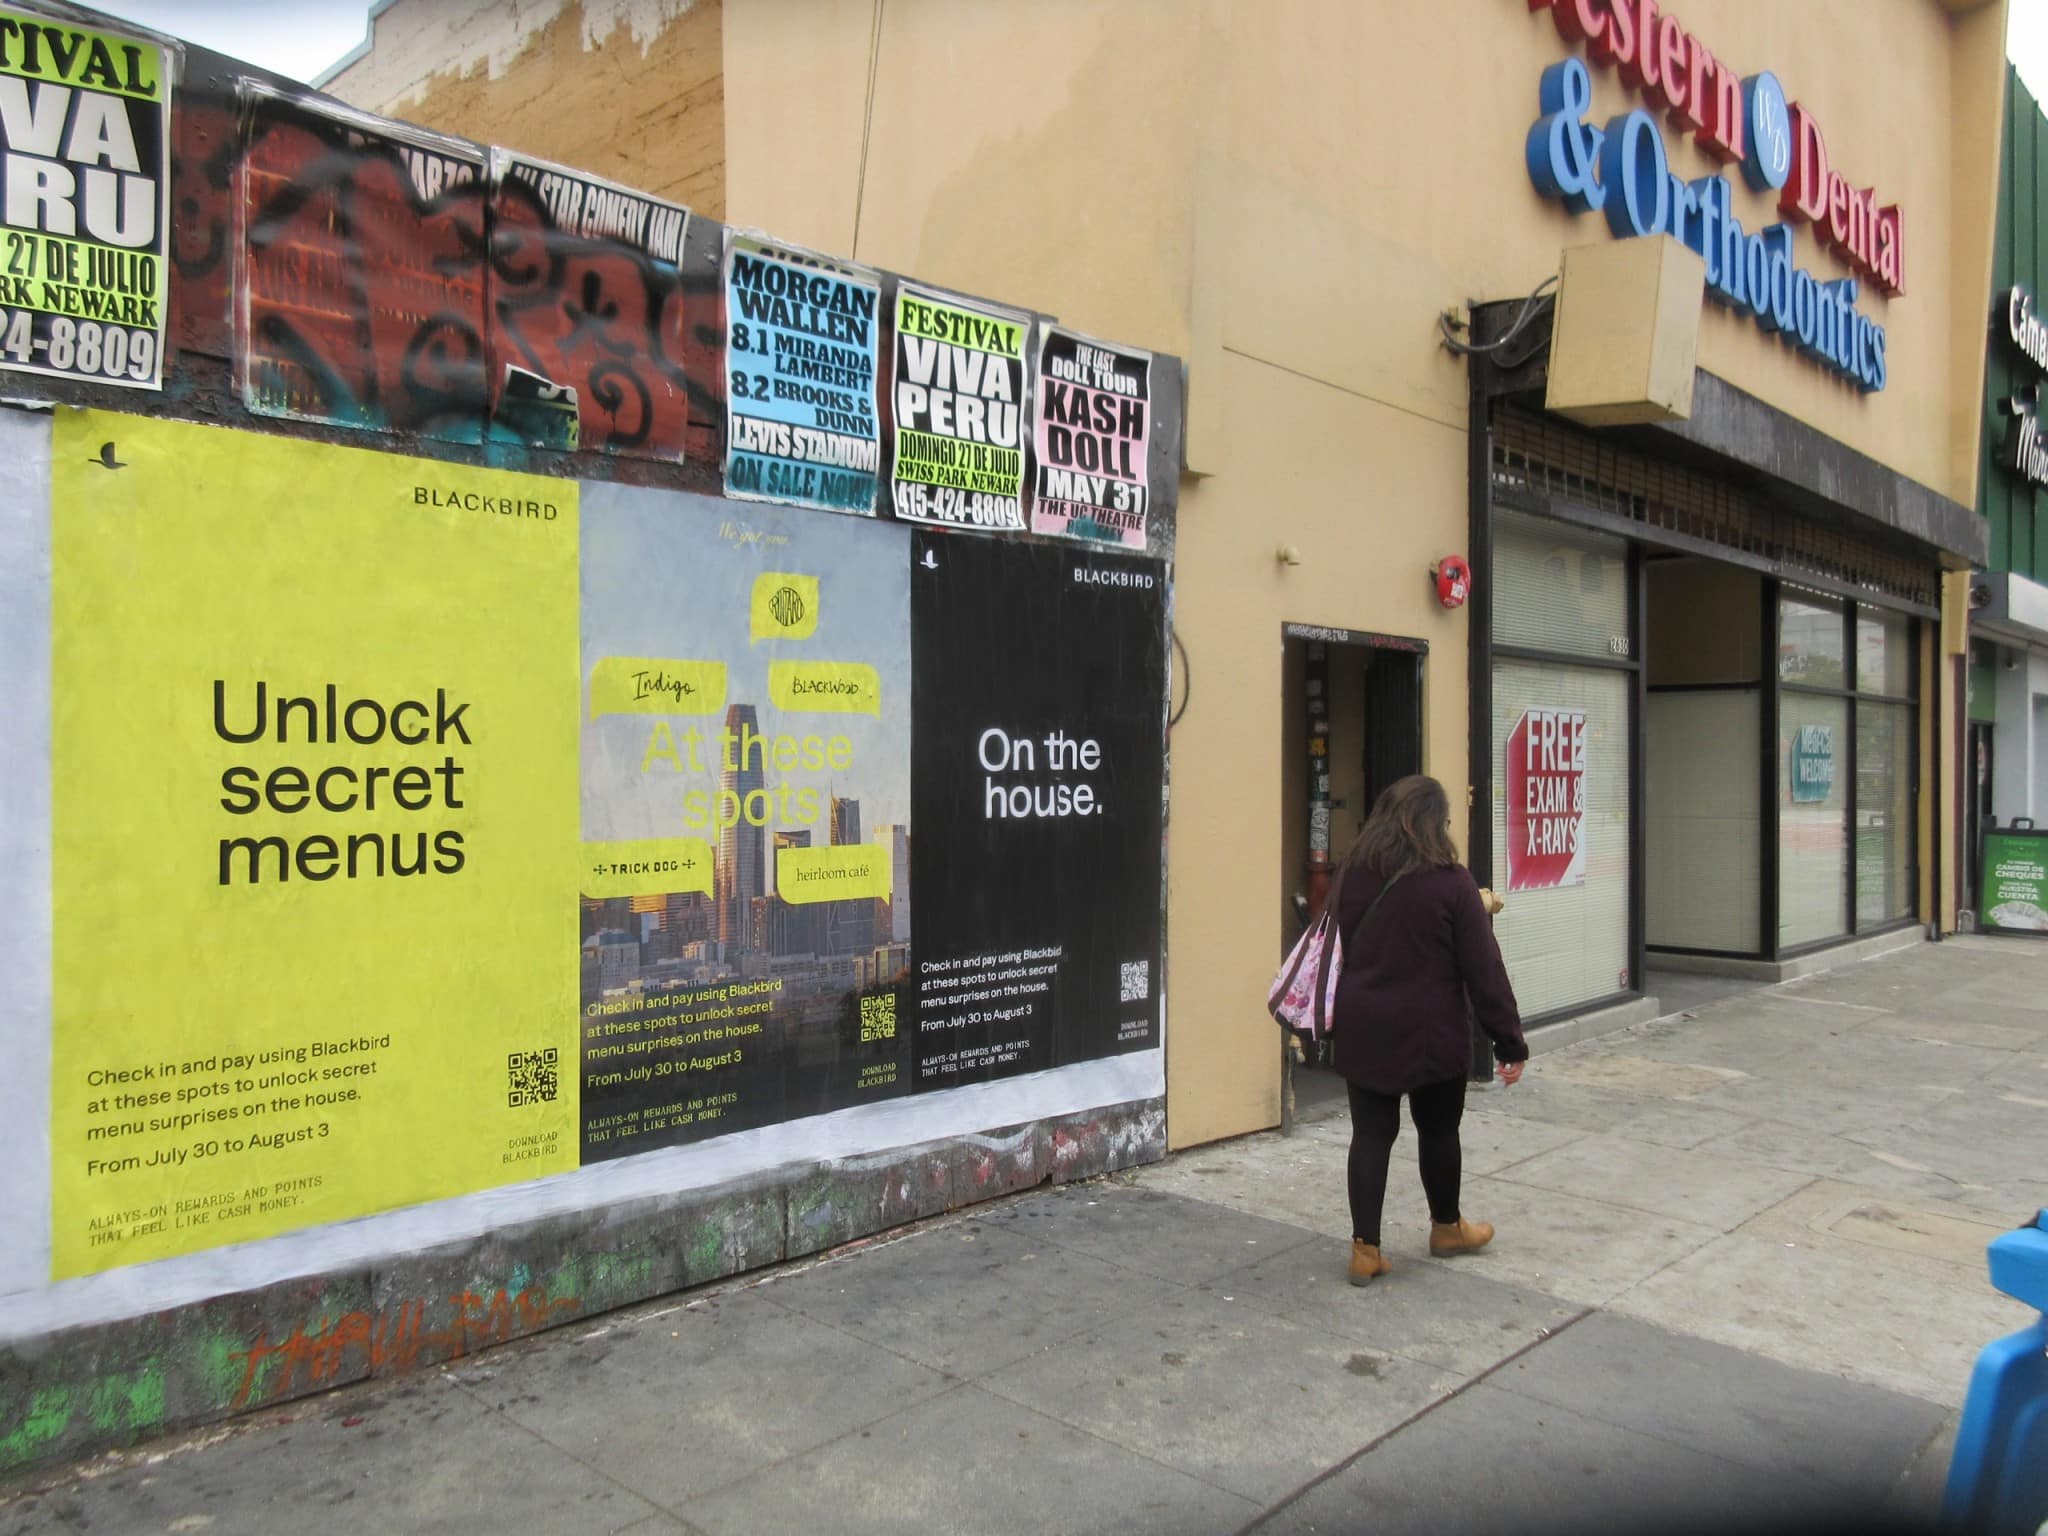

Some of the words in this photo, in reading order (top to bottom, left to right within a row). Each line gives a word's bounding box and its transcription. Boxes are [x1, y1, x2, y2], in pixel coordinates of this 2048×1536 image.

[7, 154, 155, 248] RU
[1795, 102, 1905, 297] Dental
[1539, 57, 1607, 210] &
[1612, 109, 1886, 392] Orthodontics
[7, 235, 38, 276] 27
[47, 241, 79, 284] DE
[86, 252, 155, 299] JULIO
[731, 254, 876, 320] MORGAN
[43, 283, 159, 327] NEWARK
[737, 288, 869, 348] WALLEN
[731, 323, 769, 356] 8.1
[774, 333, 872, 373] MIRANDA
[902, 299, 1018, 356] FESTIVAL
[775, 354, 871, 392] LAMBERT
[903, 334, 1012, 402] VIVA
[1052, 357, 1089, 386] DOLL
[1092, 370, 1137, 396] TOUR
[1076, 344, 1093, 365] THE
[1093, 346, 1116, 368] LAST
[731, 371, 770, 402] 8.2
[773, 378, 854, 413] BROOKS
[858, 397, 872, 415] &
[898, 381, 1017, 448] PERU
[1044, 380, 1144, 441] KASH
[815, 407, 873, 436] DUNN
[792, 428, 877, 472] STADIUM
[900, 431, 955, 467] DOMINGO
[959, 440, 972, 468] 27
[973, 446, 988, 472] DE
[990, 448, 1019, 477] JULIO
[1048, 424, 1136, 480] DOLL
[731, 456, 763, 492] ON
[768, 459, 815, 498] SALE
[897, 459, 935, 481] SWISS
[936, 466, 968, 487] PARK
[971, 472, 1019, 495] NEWARK
[1047, 468, 1107, 506] MAY
[1113, 481, 1141, 513] 31
[414, 487, 557, 521] BLACKBIRD
[898, 481, 1017, 527] 415-424-8809
[1039, 499, 1066, 516] THE
[1070, 505, 1087, 520] UC
[1091, 507, 1143, 530] THEATRE
[1074, 568, 1153, 588] BLACKBIRD
[632, 671, 695, 702] Indigo
[214, 680, 472, 745] Unlock
[641, 721, 705, 773] At
[716, 723, 853, 772] these
[978, 728, 1034, 772] On
[1044, 730, 1101, 770] the
[1527, 711, 1584, 771] FREE
[220, 757, 464, 814] secret
[985, 777, 1102, 818] house.
[1527, 776, 1567, 814] EXAM
[1573, 777, 1583, 810] &
[684, 781, 820, 843] spots
[219, 830, 465, 885] menus
[1527, 816, 1577, 856] X-RAYS
[611, 861, 650, 874] TRICK
[654, 860, 678, 873] DOG
[796, 868, 847, 882] heirloom
[848, 865, 869, 879] café
[1995, 871, 2044, 880] CHEQUES
[587, 1002, 630, 1017] Check
[632, 1001, 643, 1012] in
[647, 996, 669, 1009] and
[673, 994, 693, 1009] pay
[696, 987, 727, 1003] using
[729, 979, 782, 997] Blackbird
[921, 996, 947, 1008] menu
[949, 989, 989, 1005] surprises
[991, 987, 1002, 998] on
[1004, 985, 1018, 996] the
[1020, 981, 1048, 993] house.
[587, 1026, 602, 1038] at
[606, 1020, 641, 1036] these
[644, 1015, 677, 1032] spots
[680, 1012, 693, 1025] to
[696, 1006, 734, 1021] unlock
[737, 1001, 773, 1015] secret
[921, 1019, 945, 1032] From
[947, 1014, 966, 1027] July
[968, 1012, 981, 1024] 30
[984, 1009, 992, 1021] to
[994, 1006, 1024, 1021] August
[1026, 1005, 1032, 1015] 3
[87, 1066, 154, 1087] Check
[160, 1063, 176, 1077] in
[182, 1056, 216, 1074] and
[222, 1054, 255, 1072] pay
[259, 1047, 307, 1064] using
[312, 1035, 390, 1057] Blackbird
[588, 1045, 624, 1060] menu
[627, 1035, 683, 1055] surprises
[686, 1032, 700, 1044] on
[703, 1026, 723, 1040] the
[726, 1022, 763, 1037] house.
[88, 1101, 108, 1113] at
[115, 1089, 171, 1110] these
[177, 1082, 230, 1102] spots
[236, 1079, 254, 1093] to
[259, 1070, 317, 1089] unlock
[322, 1061, 377, 1080] secret
[588, 1073, 621, 1088] From
[624, 1066, 652, 1084] July
[655, 1062, 671, 1075] 30
[675, 1060, 687, 1073] to
[690, 1053, 732, 1071] August
[734, 1050, 742, 1063] 3
[88, 1123, 144, 1141] menu
[150, 1108, 238, 1131] surprises
[243, 1103, 266, 1117] on
[271, 1097, 300, 1111] the
[305, 1088, 361, 1106] house.
[88, 1157, 140, 1176] From
[146, 1148, 188, 1167] July
[193, 1142, 218, 1158] 30
[224, 1139, 244, 1153] to
[249, 1127, 313, 1149] August
[318, 1123, 329, 1137] 3
[503, 1144, 557, 1164] BLACKBIRD
[509, 1131, 557, 1149] DOWNLOAD
[89, 1205, 167, 1231] ALWAYS-ON
[176, 1192, 235, 1213] REWARDS
[244, 1186, 267, 1200] AND
[275, 1176, 322, 1194] POINTS
[89, 1231, 122, 1247] THAT
[133, 1222, 167, 1238] FEEL
[176, 1215, 210, 1229] LIKE
[218, 1204, 251, 1220] CASH
[260, 1197, 305, 1213] MONEY.
